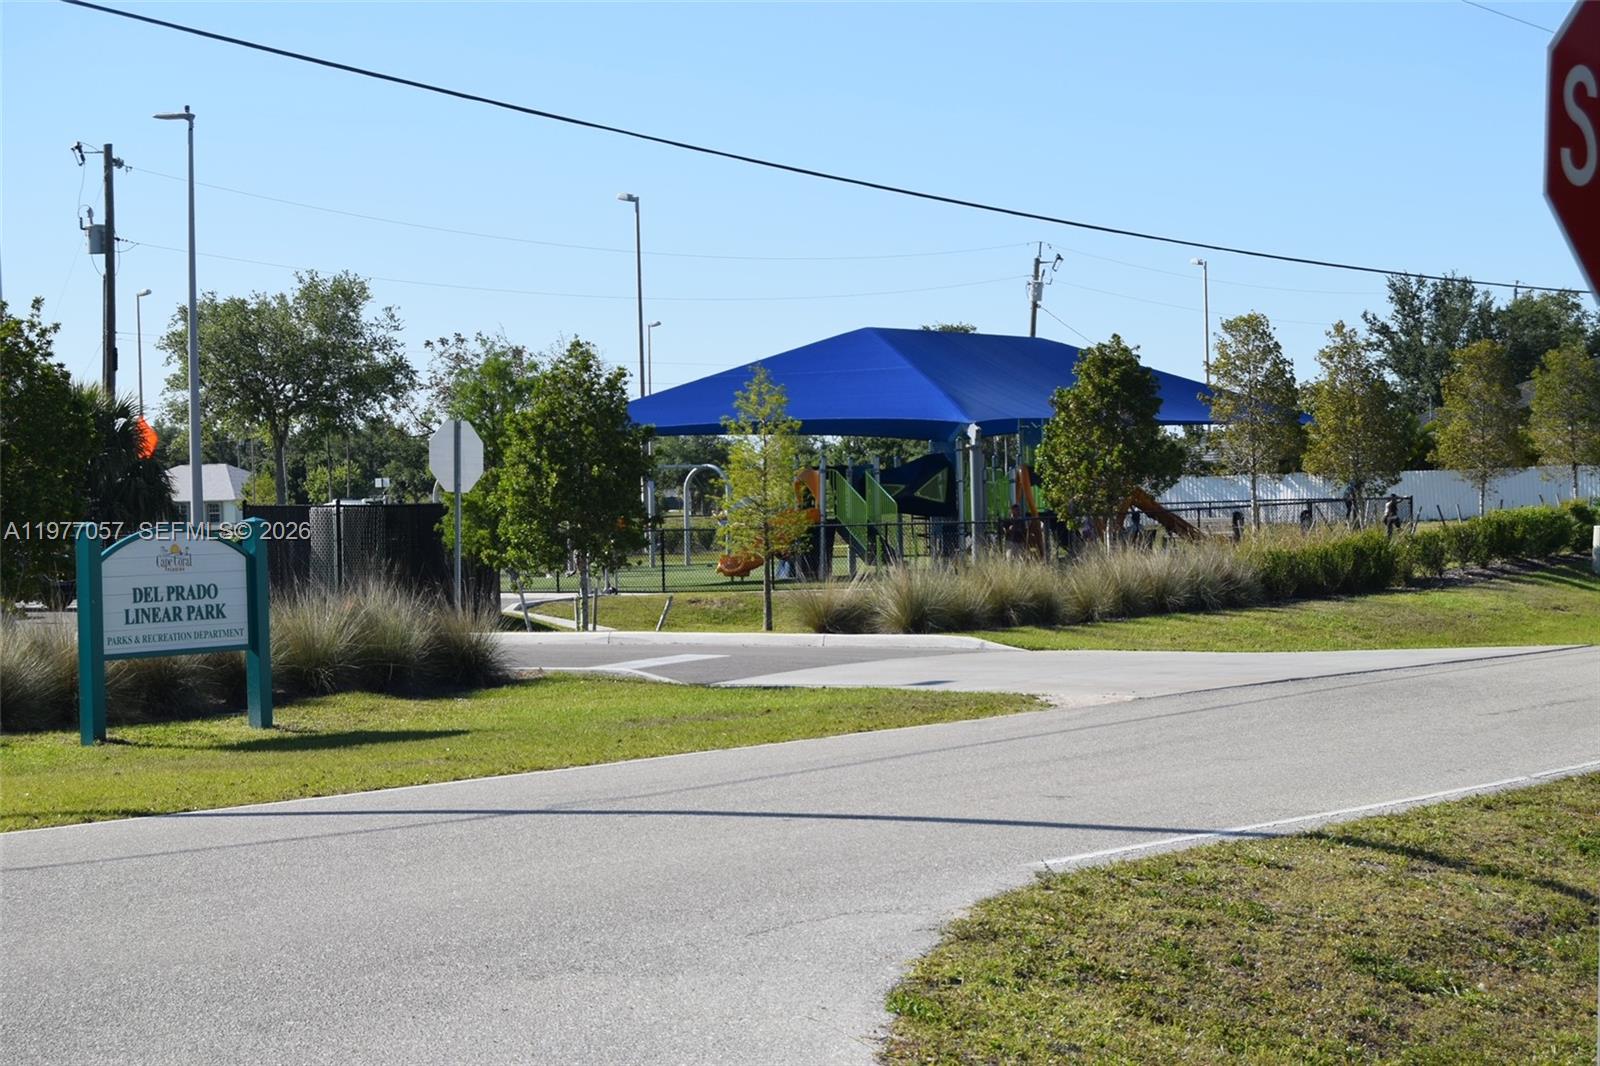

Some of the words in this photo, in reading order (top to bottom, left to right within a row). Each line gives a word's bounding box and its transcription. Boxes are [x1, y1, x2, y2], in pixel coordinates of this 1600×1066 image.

[132, 586, 164, 604] DEL
[166, 583, 218, 602] PRADO
[124, 606, 183, 625] LINEAR
[186, 603, 227, 622] PARK
[107, 635, 133, 646] PARKS
[134, 635, 141, 645] &
[142, 631, 192, 643] RECREATION
[194, 628, 245, 640] DEPARTMENT
